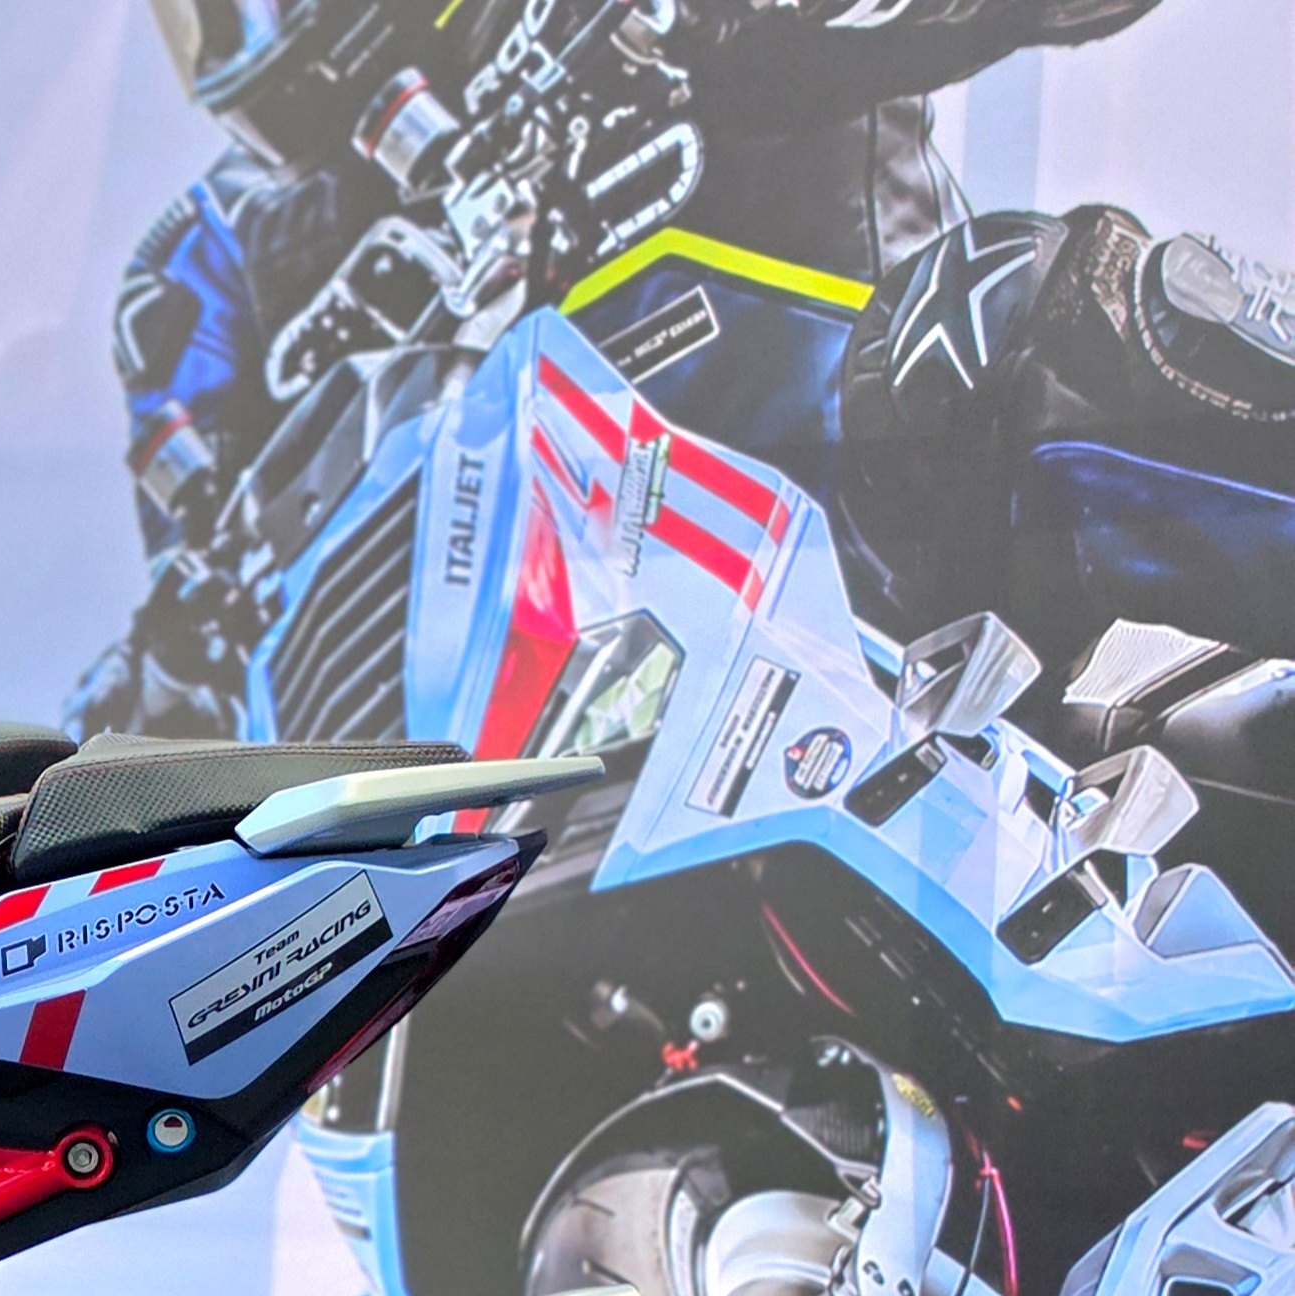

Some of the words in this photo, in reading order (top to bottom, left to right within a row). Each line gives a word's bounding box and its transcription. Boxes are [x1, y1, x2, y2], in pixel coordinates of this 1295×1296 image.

[444, 453, 485, 587] ITALJET
[187, 961, 281, 1030] GRESINI
[285, 899, 372, 965] RACING
[253, 929, 301, 965] Team
[253, 962, 334, 1022] MotoGP
